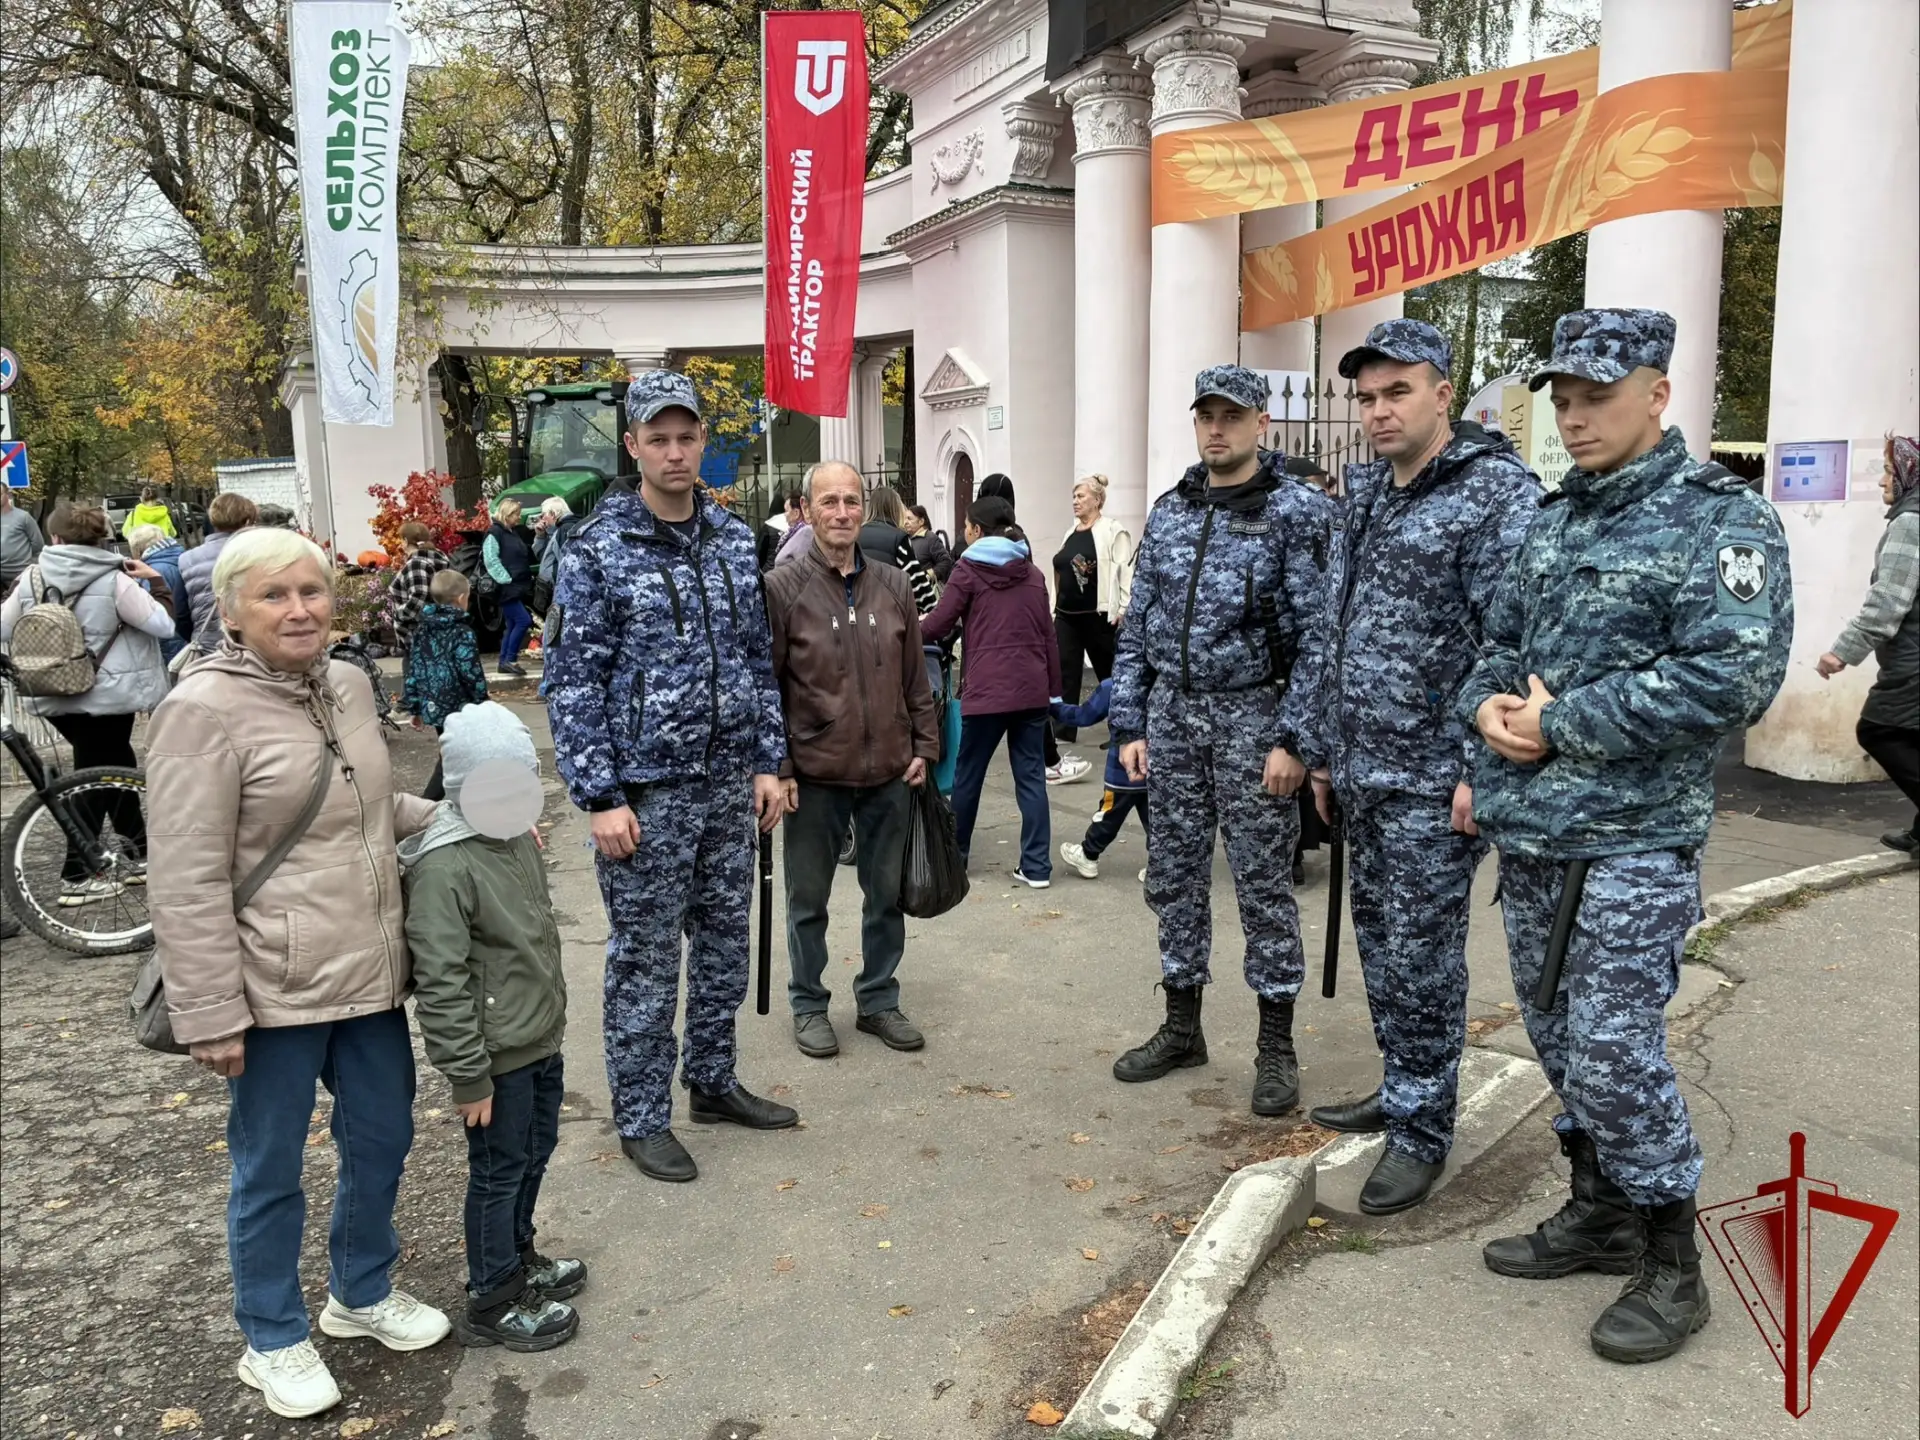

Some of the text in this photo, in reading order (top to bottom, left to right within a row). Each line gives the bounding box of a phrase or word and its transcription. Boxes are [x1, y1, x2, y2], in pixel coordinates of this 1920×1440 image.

[326, 28, 361, 232] СЕЛЬХОЗ
[1343, 73, 1579, 188] ДЕНЬ
[1348, 157, 1526, 297] УРОЖАЯ
[800, 258, 824, 381] ТРАКТОР
